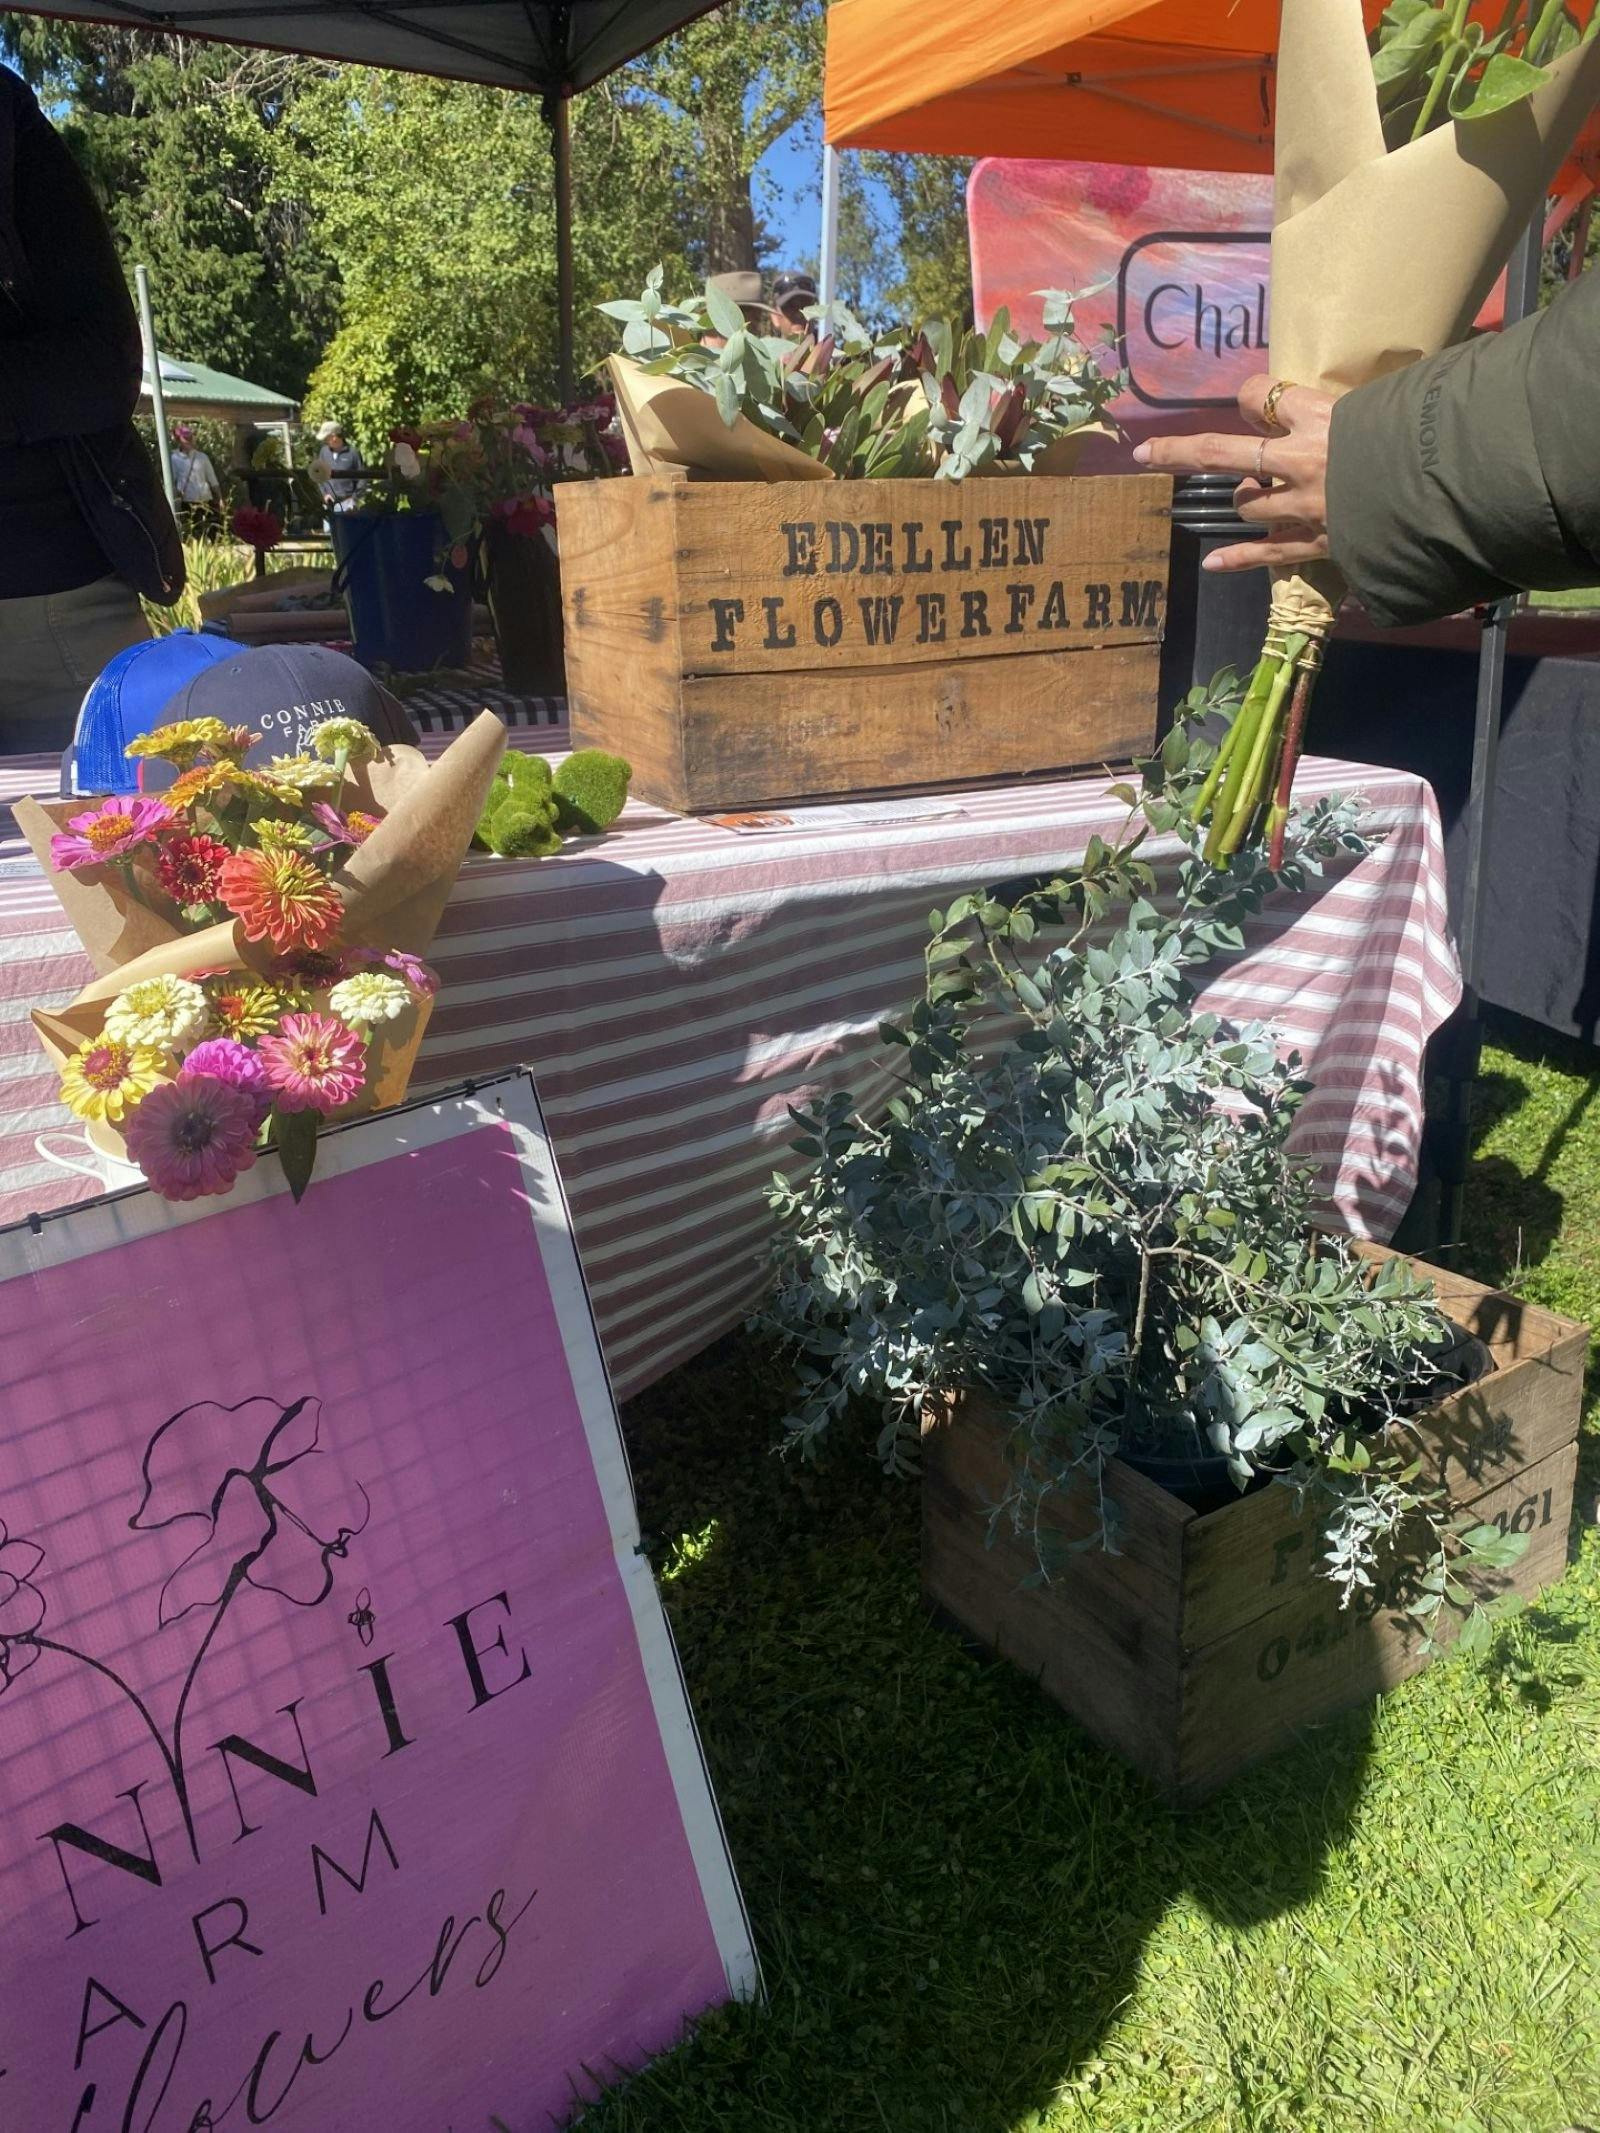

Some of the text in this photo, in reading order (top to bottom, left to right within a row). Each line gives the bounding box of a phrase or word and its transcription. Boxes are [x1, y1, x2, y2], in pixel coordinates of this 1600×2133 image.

[779, 517, 1050, 577] EDELLEN
[260, 699, 346, 729] CONNIE
[283, 717, 334, 738] FAR
[0, 1807, 400, 2078] ARM
